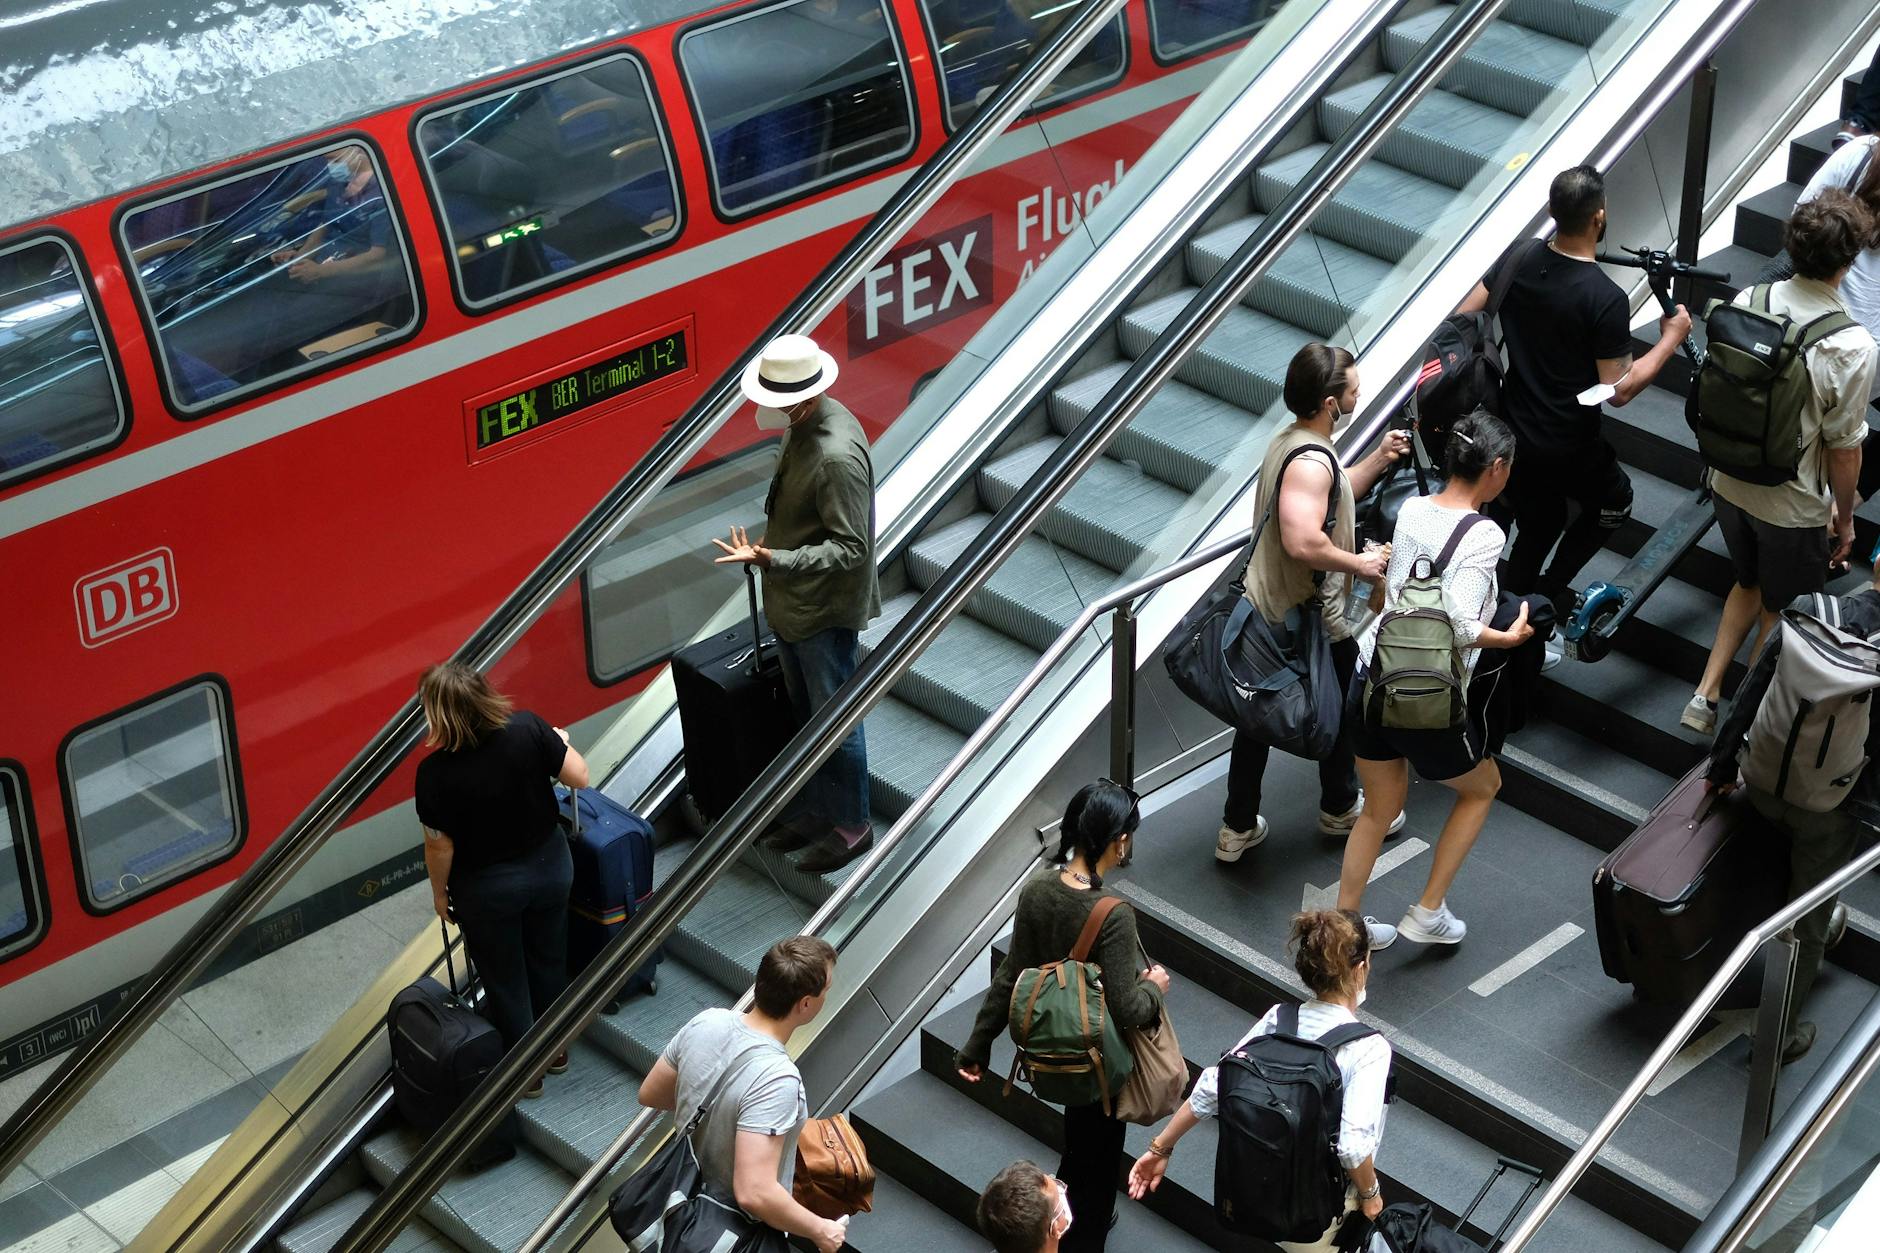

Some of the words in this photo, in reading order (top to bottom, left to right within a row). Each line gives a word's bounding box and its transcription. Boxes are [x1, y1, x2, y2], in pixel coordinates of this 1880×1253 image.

[865, 231, 979, 340] FEX
[1685, 334, 1704, 366] SOFLO
[480, 389, 539, 443] FEX
[552, 376, 579, 410] BER
[584, 349, 645, 397] Terminal
[651, 338, 676, 371] 1-2
[89, 566, 164, 633] DB
[25, 1043, 34, 1056] 3
